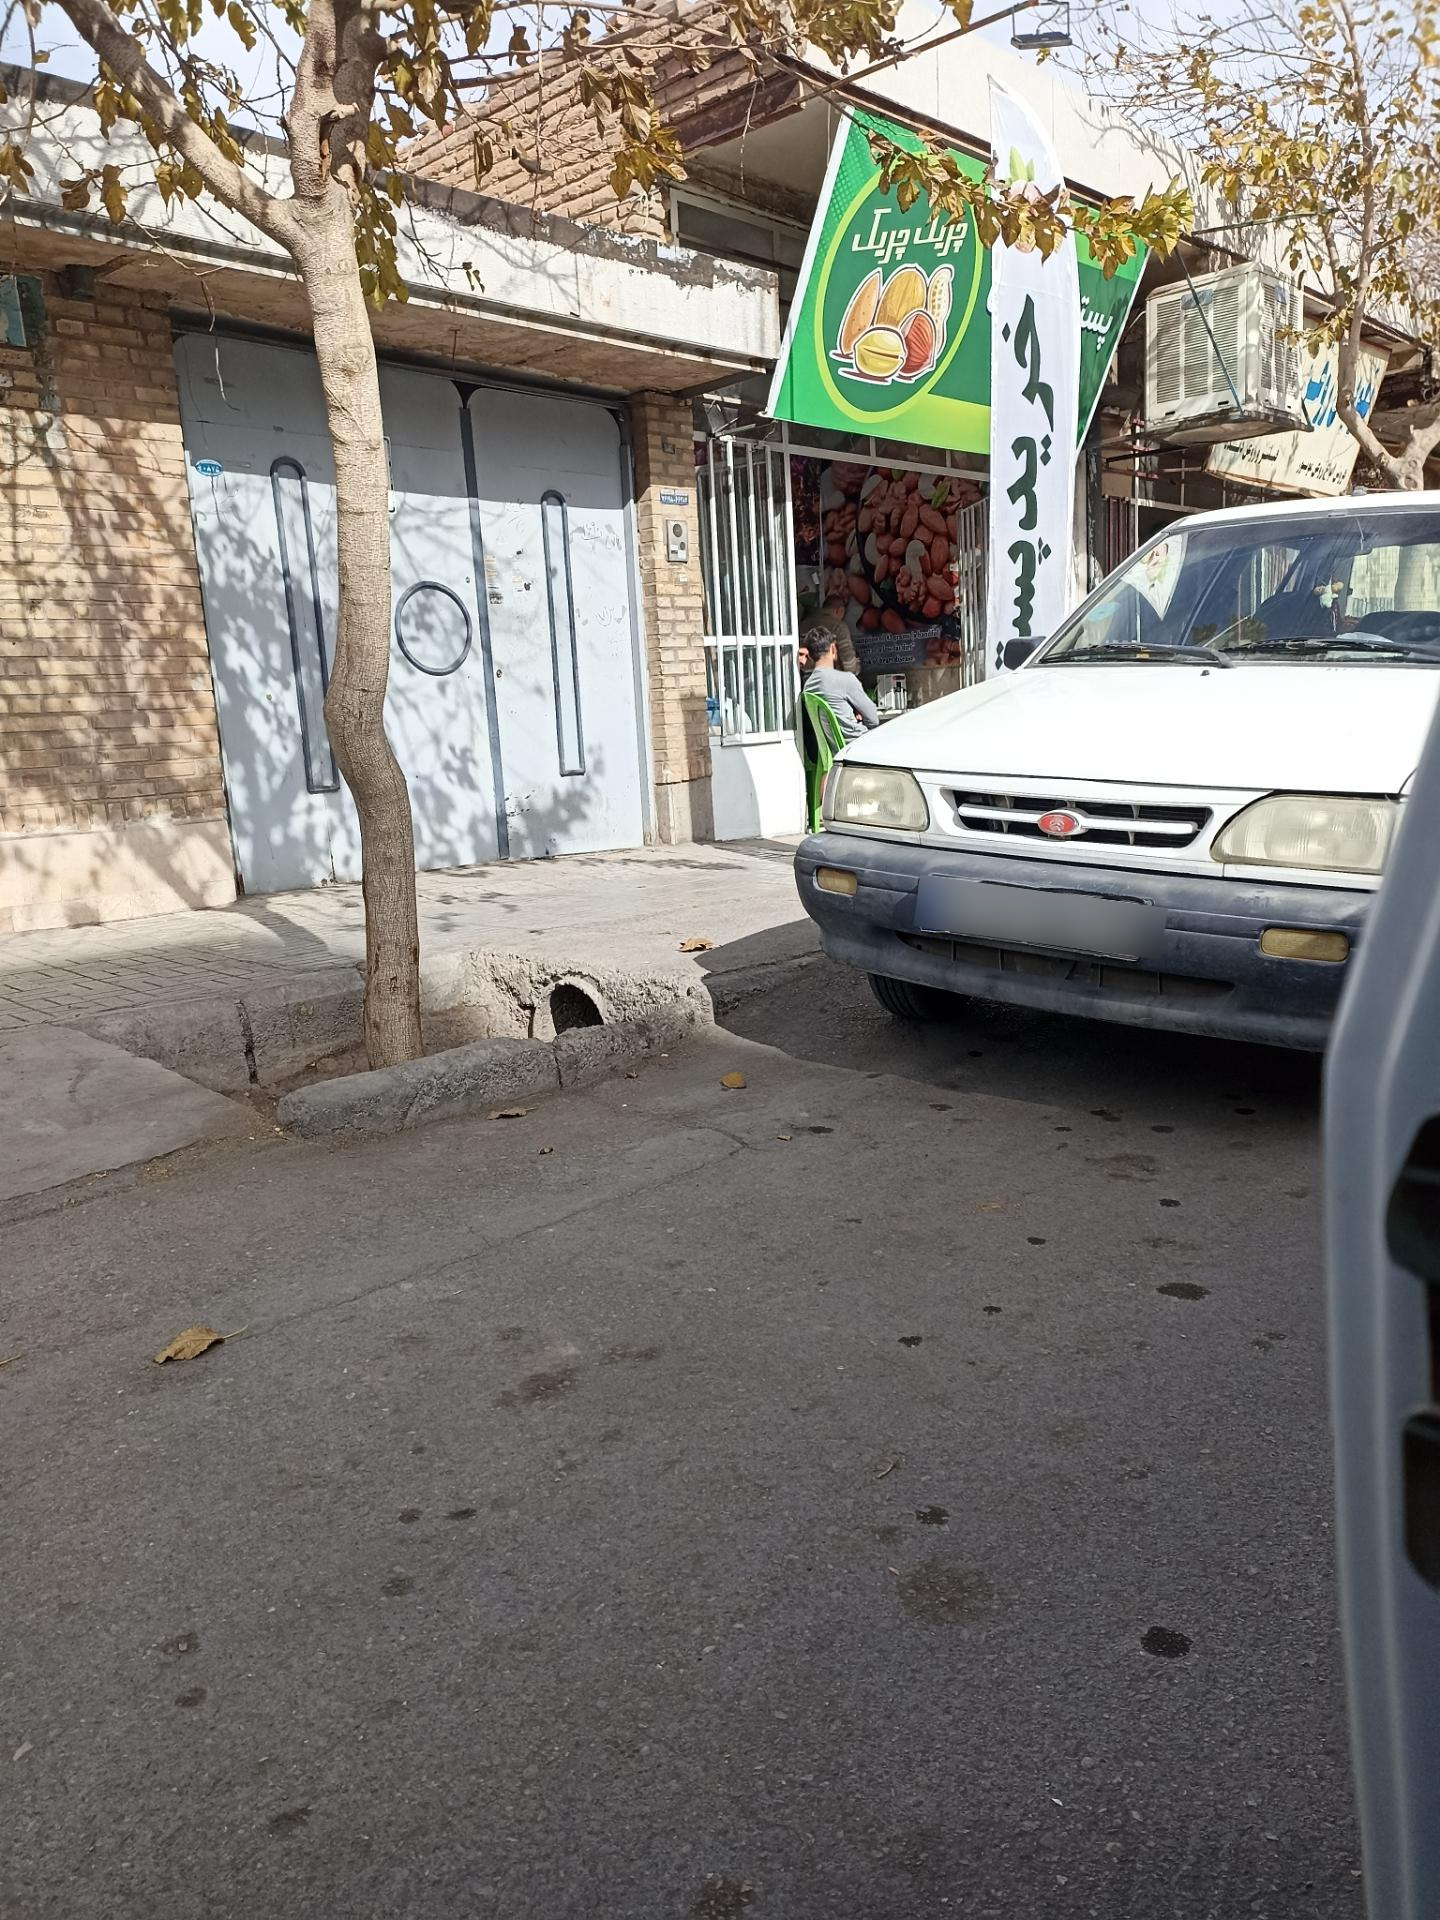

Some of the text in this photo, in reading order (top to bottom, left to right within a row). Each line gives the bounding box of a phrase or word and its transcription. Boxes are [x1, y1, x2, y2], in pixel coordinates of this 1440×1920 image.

[1080, 295, 1114, 351] پست
[993, 293, 1055, 672] خرید پست
